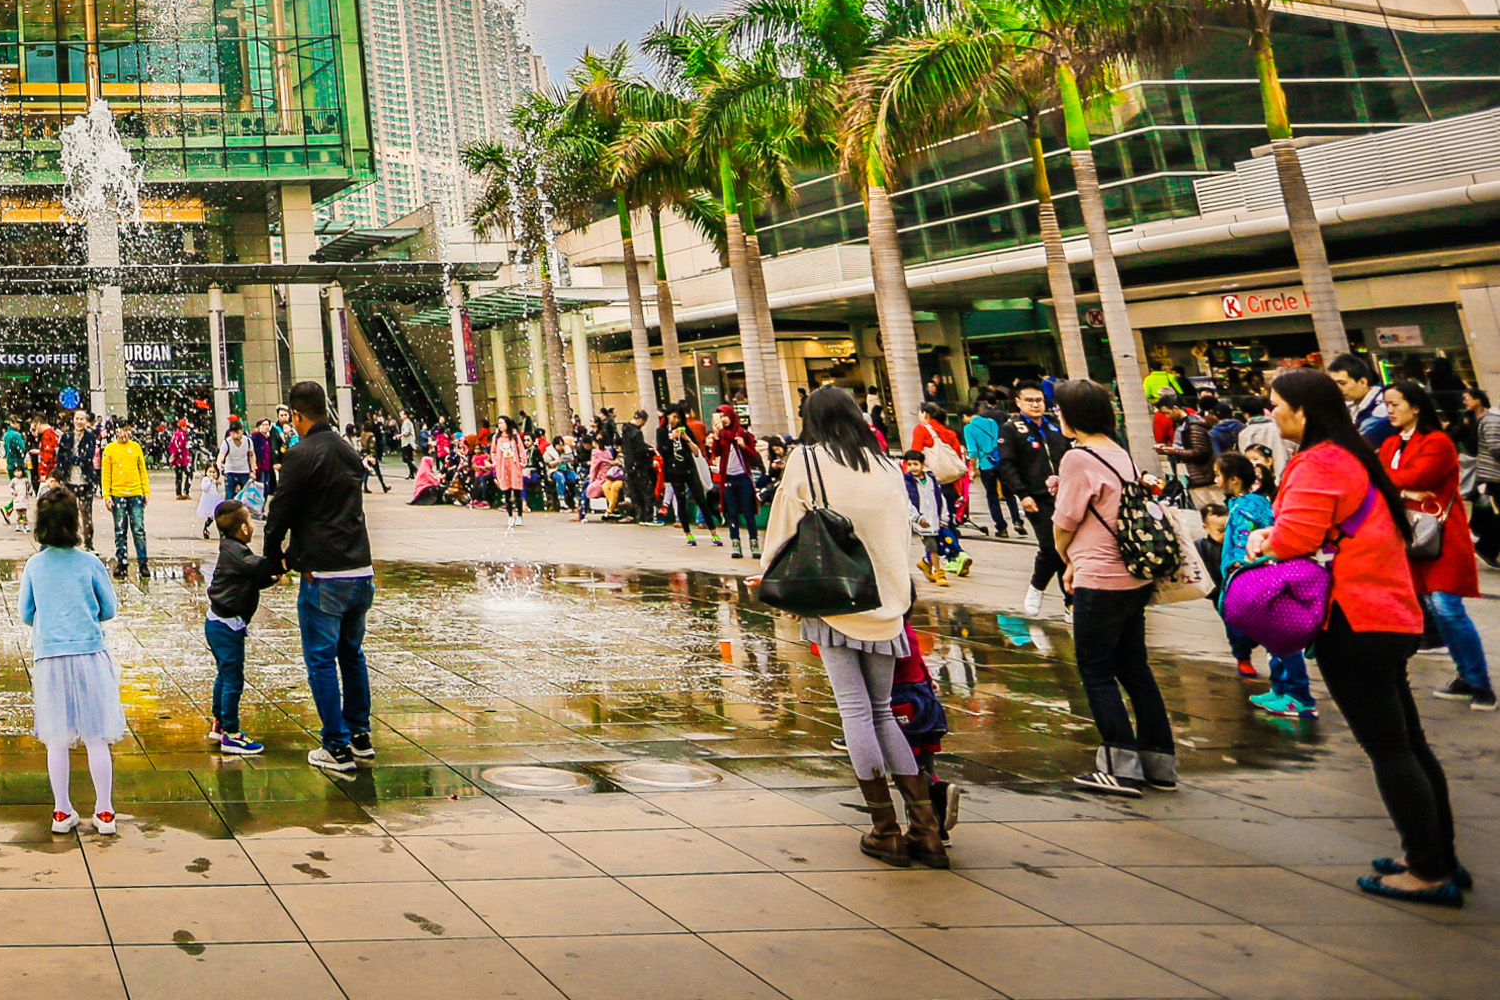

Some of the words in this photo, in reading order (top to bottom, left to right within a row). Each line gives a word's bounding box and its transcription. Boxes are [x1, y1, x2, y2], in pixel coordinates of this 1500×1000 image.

[1247, 292, 1298, 313] Circle
[27, 353, 77, 365] COFFEE
[124, 344, 172, 362] URBAN
[1013, 421, 1029, 434] 5
